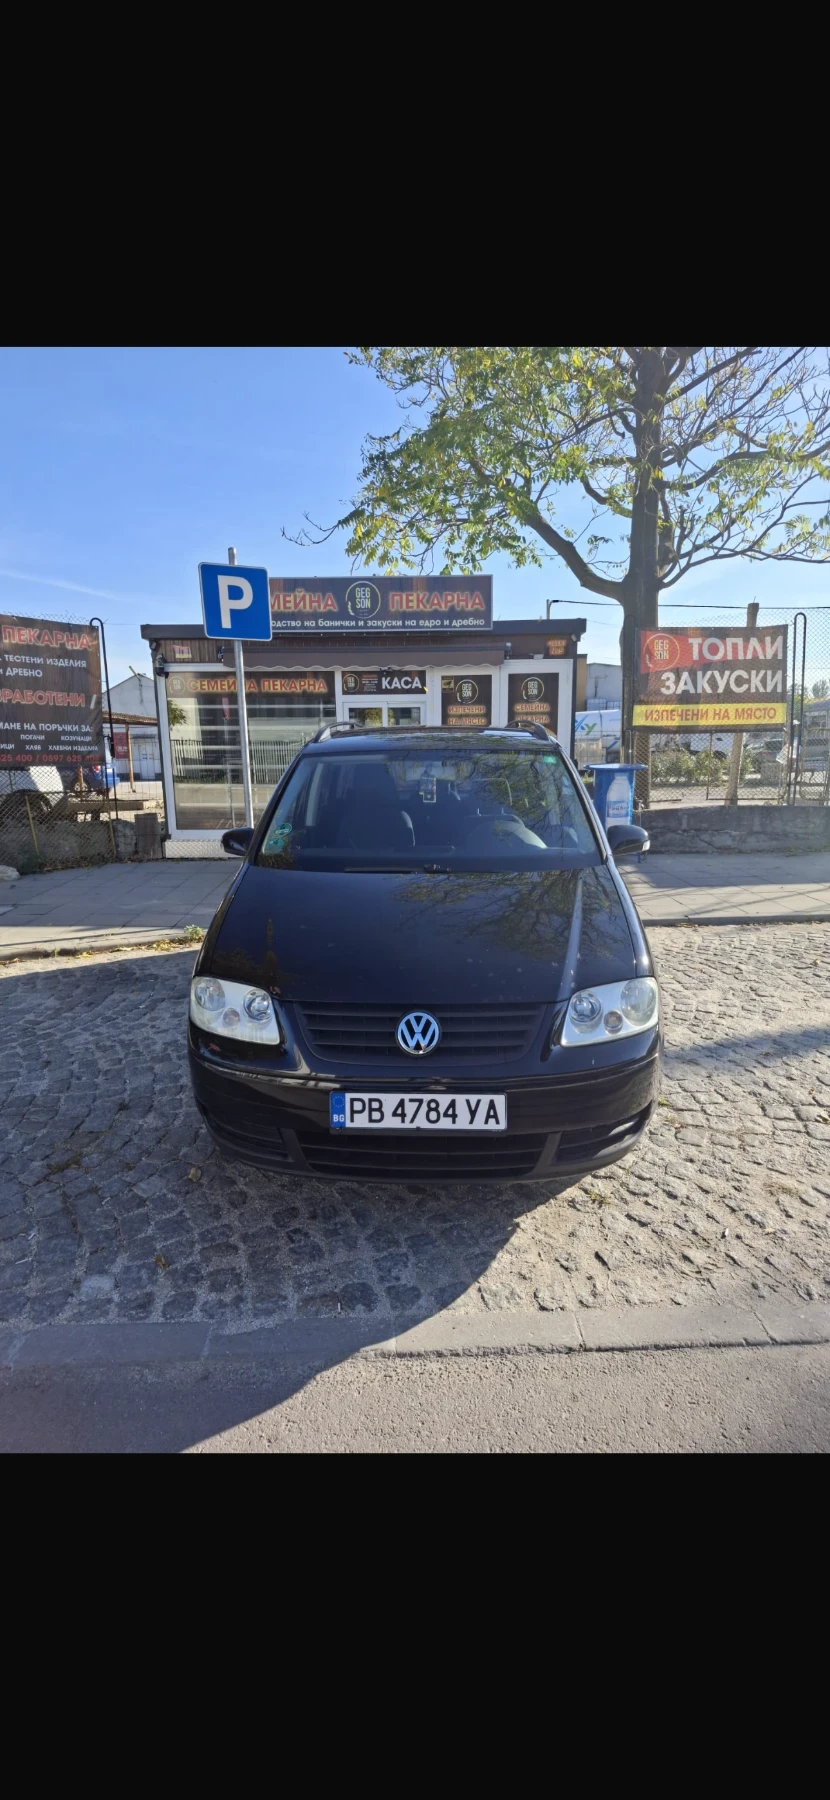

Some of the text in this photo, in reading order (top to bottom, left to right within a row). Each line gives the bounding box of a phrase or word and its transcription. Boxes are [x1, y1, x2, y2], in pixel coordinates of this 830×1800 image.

[355, 587, 371, 598] GEG
[217, 575, 253, 629] P
[355, 598, 371, 609] SON
[389, 591, 485, 611] ПЕКАРНА
[318, 618, 356, 627] банички
[366, 619, 403, 628] закуски
[419, 618, 442, 628] едро
[452, 617, 485, 627] дребно
[2, 625, 92, 650] ПЕКАРНА
[654, 639, 669, 650] GEG
[688, 636, 783, 661] ТОПЛИ
[4, 654, 87, 668] ТЕСТЕНИ ИЗДЕЛИЯ
[654, 651, 669, 660] SON
[5, 667, 43, 677] ДРЕБНО
[188, 676, 258, 693] СЕМЕЙА
[261, 678, 327, 692] ПЕКАРНА
[382, 677, 422, 689] КАСА
[461, 683, 472, 691] GEG
[660, 670, 783, 695] ЗАКУСКИ
[447, 705, 487, 715] ИЗПЕЧЕНИ
[514, 702, 551, 712] СЕМЕЙНА
[644, 707, 777, 722] ИЗПЕЧЕНИ НА МЯСТО
[39, 723, 79, 732] ПОРЪЧКИ
[349, 1097, 500, 1125] PB 4784 YA
[333, 1114, 345, 1122] BG
